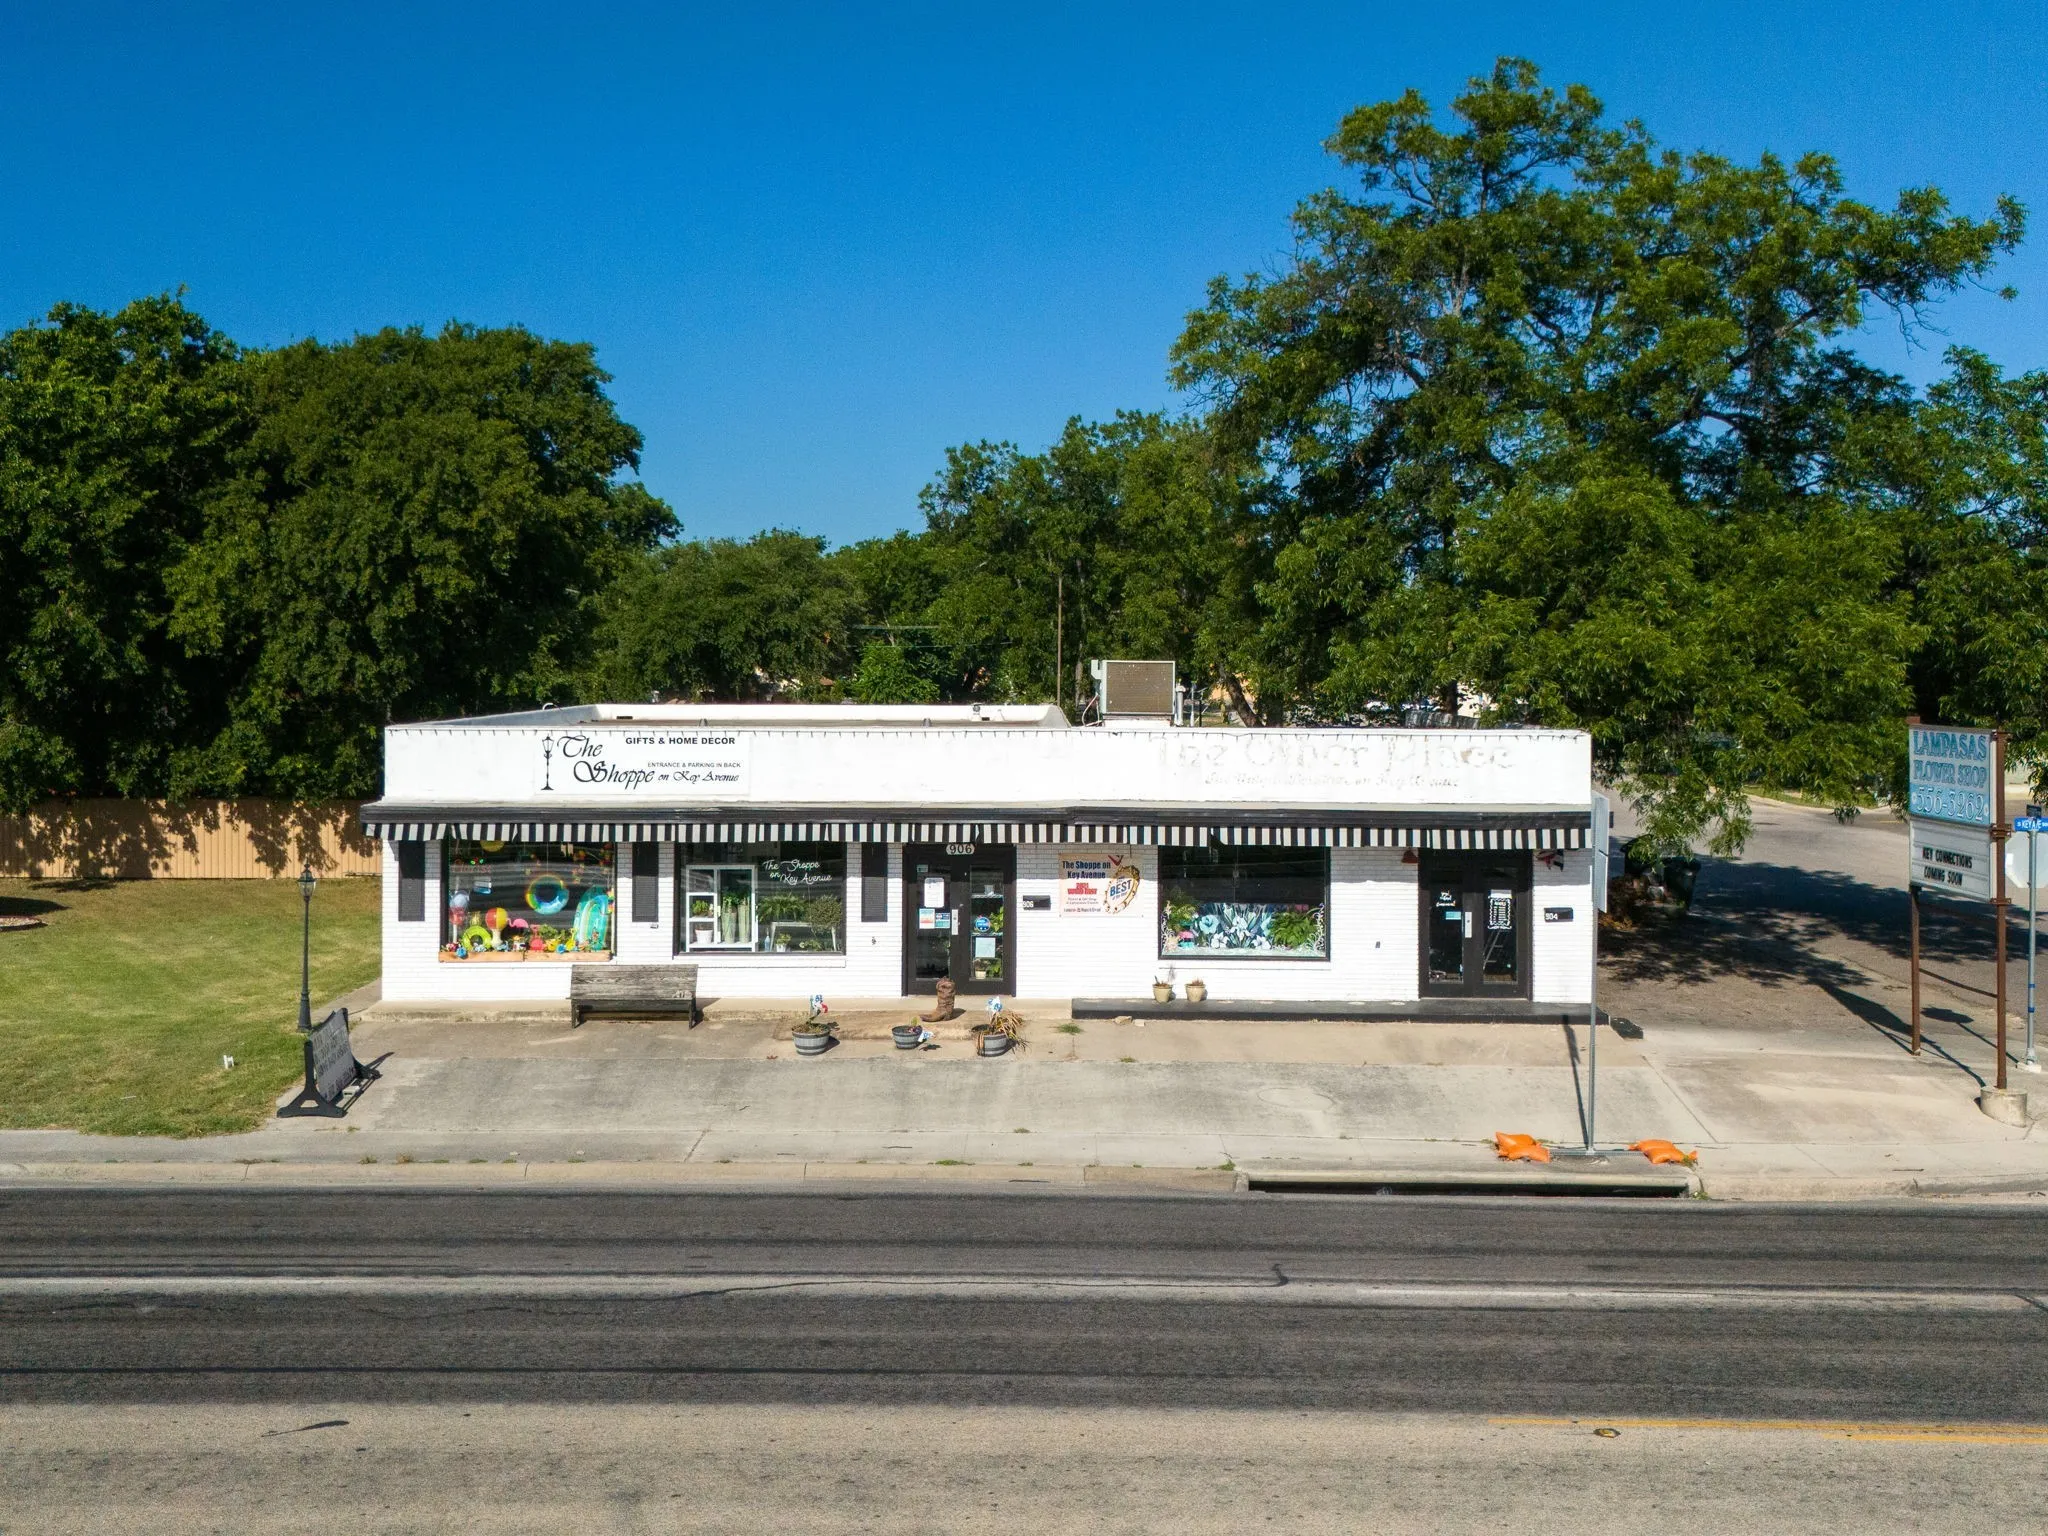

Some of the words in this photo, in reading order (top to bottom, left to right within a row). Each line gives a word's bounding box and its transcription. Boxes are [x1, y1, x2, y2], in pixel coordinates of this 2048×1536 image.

[556, 735, 603, 758] The
[625, 737, 655, 745] GIFTS
[658, 737, 665, 745] &
[669, 737, 698, 745] HOME
[701, 737, 735, 745] DECOR
[1913, 731, 1987, 761] LAMPASAS
[573, 760, 655, 790] Shoppe
[702, 771, 739, 782] Avenue
[1913, 760, 1955, 784] FLOWER
[1957, 764, 1987, 788] SHOP
[950, 844, 972, 853] 906
[1062, 861, 1074, 869] The
[1076, 860, 1101, 870] Shoppe
[1102, 861, 1111, 869] on
[1922, 847, 1934, 861] KEY
[1936, 848, 1973, 868] CONNECTIONS
[763, 860, 779, 870] The
[781, 859, 820, 872] Shoppe
[779, 873, 799, 885] Key
[801, 872, 832, 885] Avenue
[1067, 871, 1080, 880] Key
[1081, 871, 1106, 879] Avenue
[1924, 867, 1946, 882] COMING
[1947, 871, 1963, 886] SOON
[1109, 880, 1132, 897] BEST
